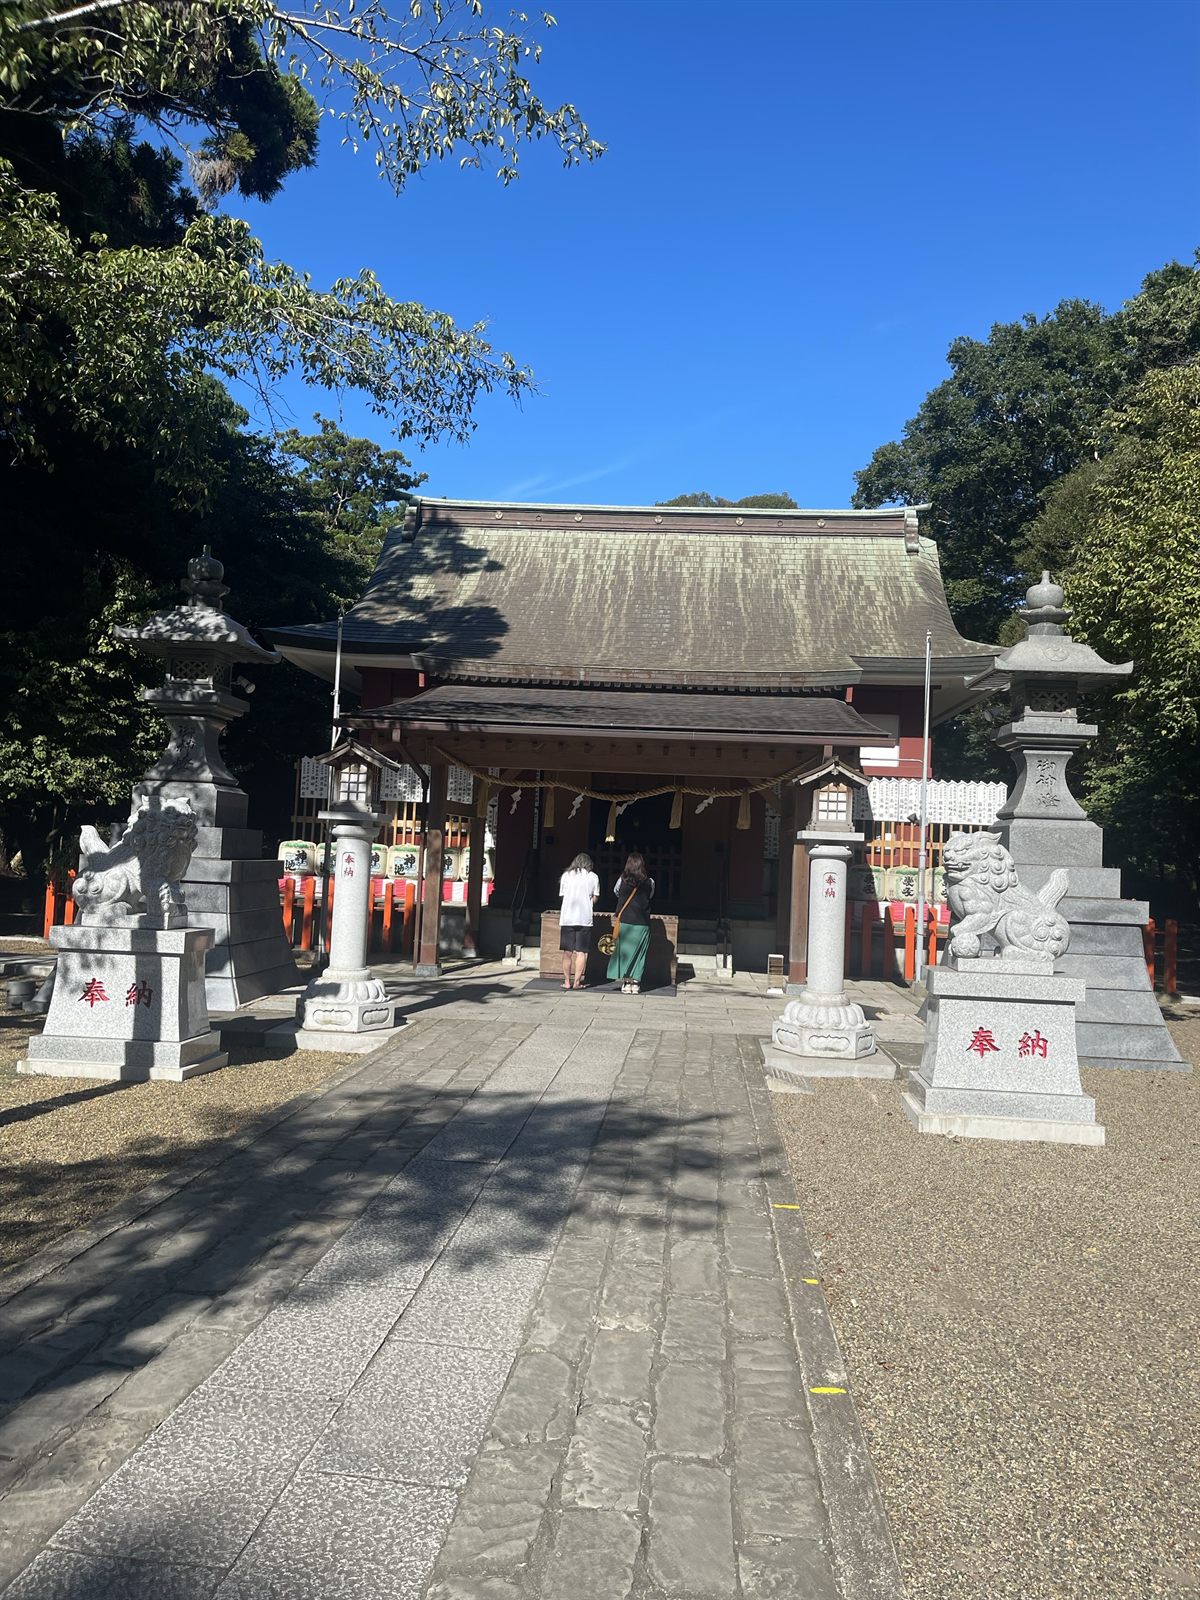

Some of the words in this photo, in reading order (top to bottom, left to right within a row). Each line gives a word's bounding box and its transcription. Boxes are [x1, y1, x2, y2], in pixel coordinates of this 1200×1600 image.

[344, 854, 355, 878] 奉納
[825, 874, 836, 898] 奉納
[78, 977, 153, 1008] 奉納
[966, 1026, 1048, 1059] 奉納
